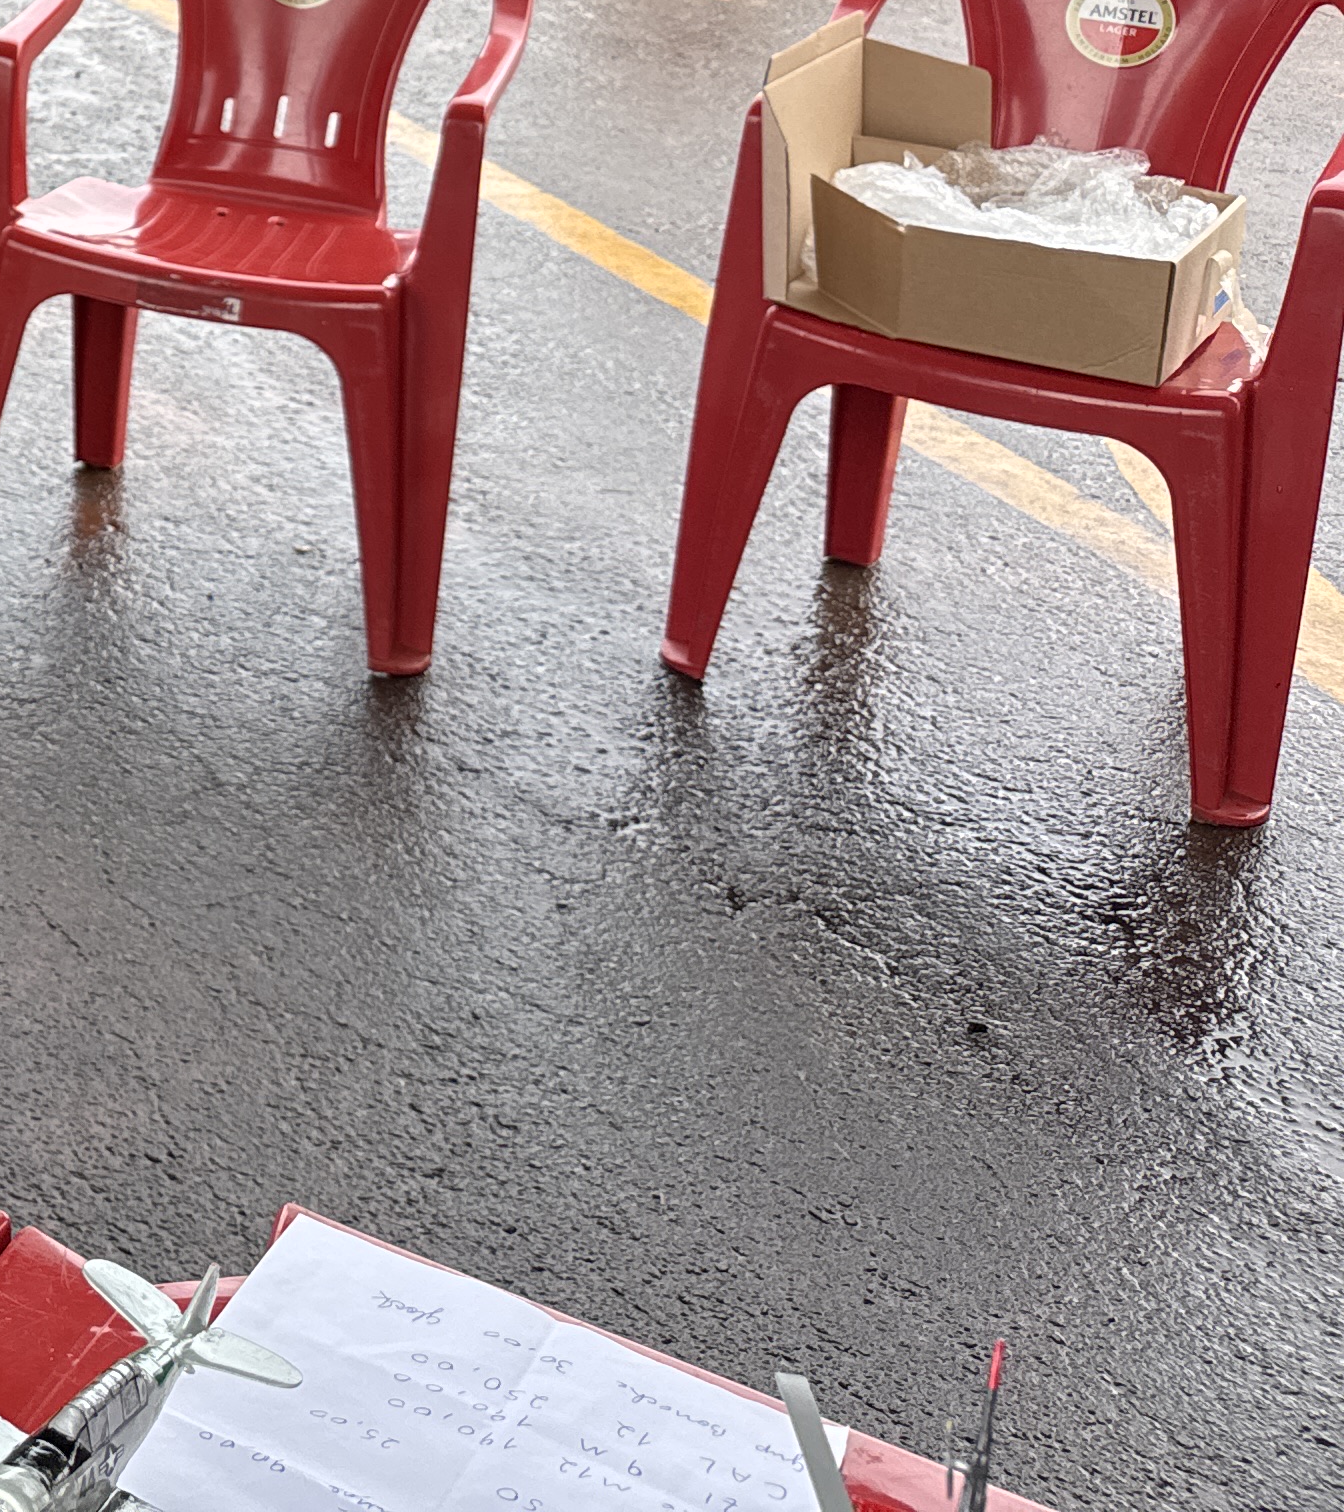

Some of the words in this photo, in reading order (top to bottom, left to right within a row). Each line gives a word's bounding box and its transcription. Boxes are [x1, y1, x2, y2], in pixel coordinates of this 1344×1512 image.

[1088, 3, 1158, 25] AMSTEL
[1098, 23, 1138, 37] LAGER
[616, 1420, 652, 1447] 12
